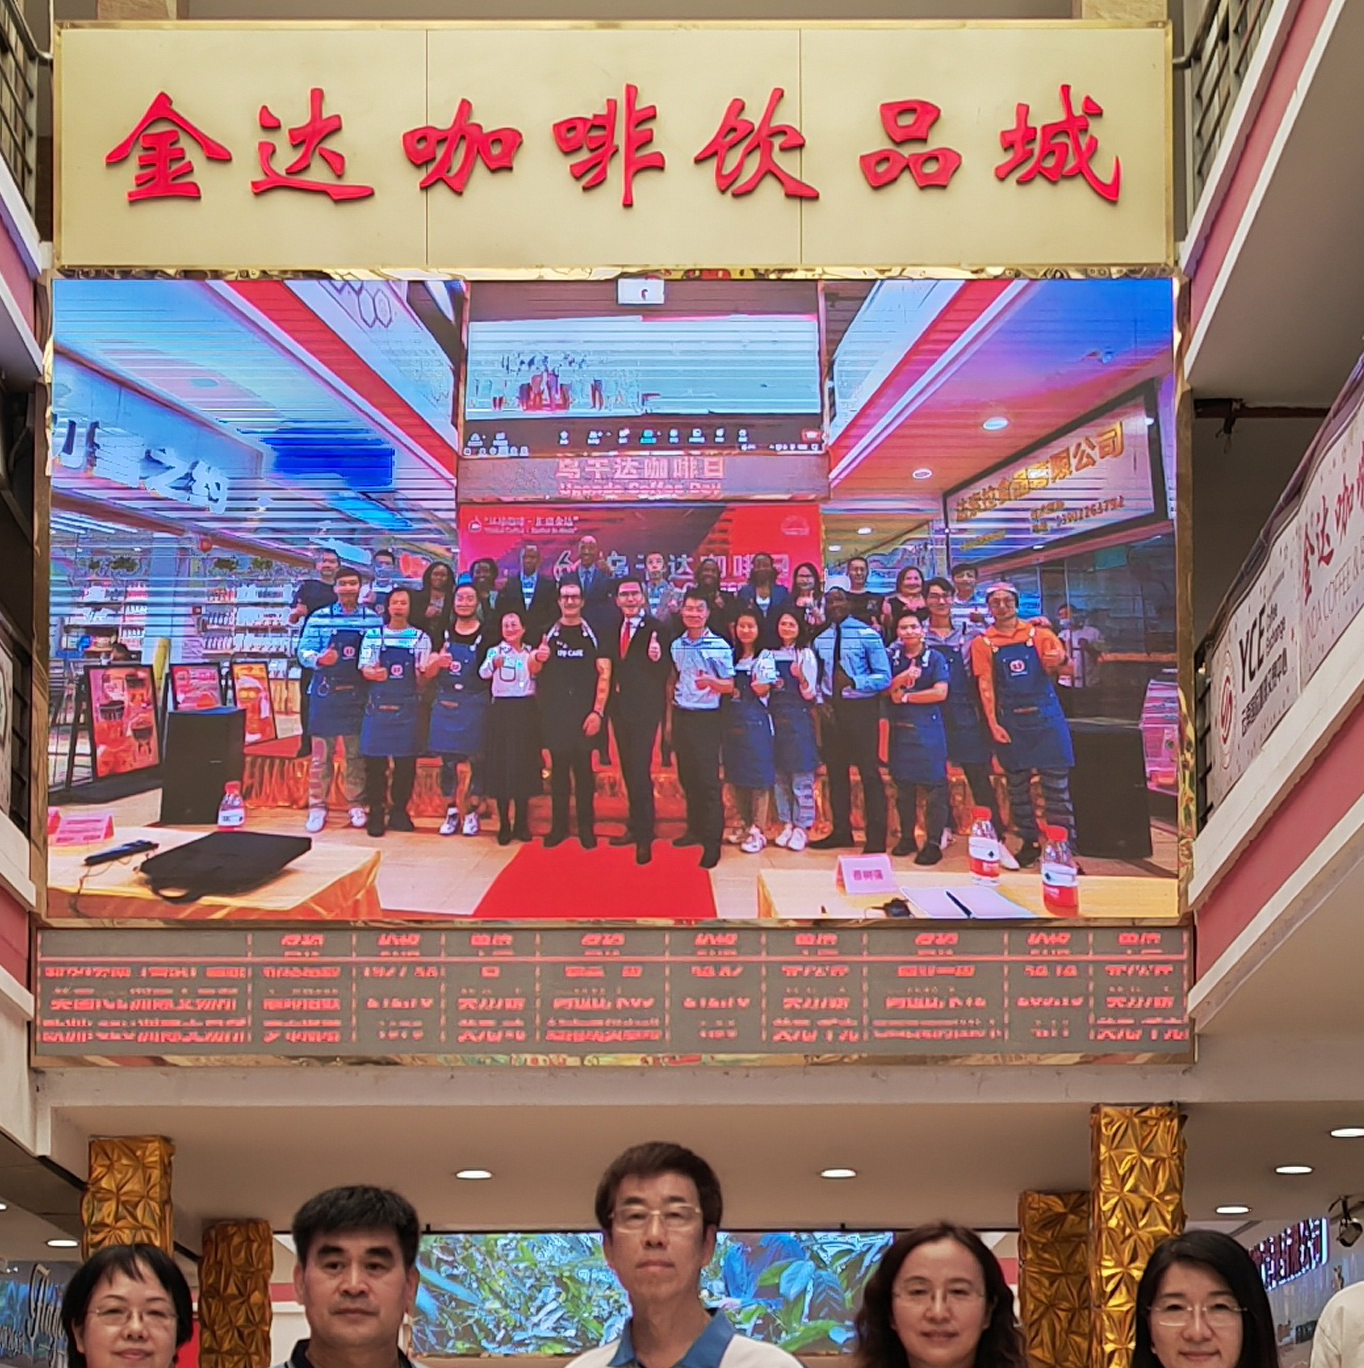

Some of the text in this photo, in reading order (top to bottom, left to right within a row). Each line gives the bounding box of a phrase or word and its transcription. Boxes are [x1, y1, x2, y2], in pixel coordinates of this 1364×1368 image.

[105, 83, 1122, 207] 金达咖啡饮品城
